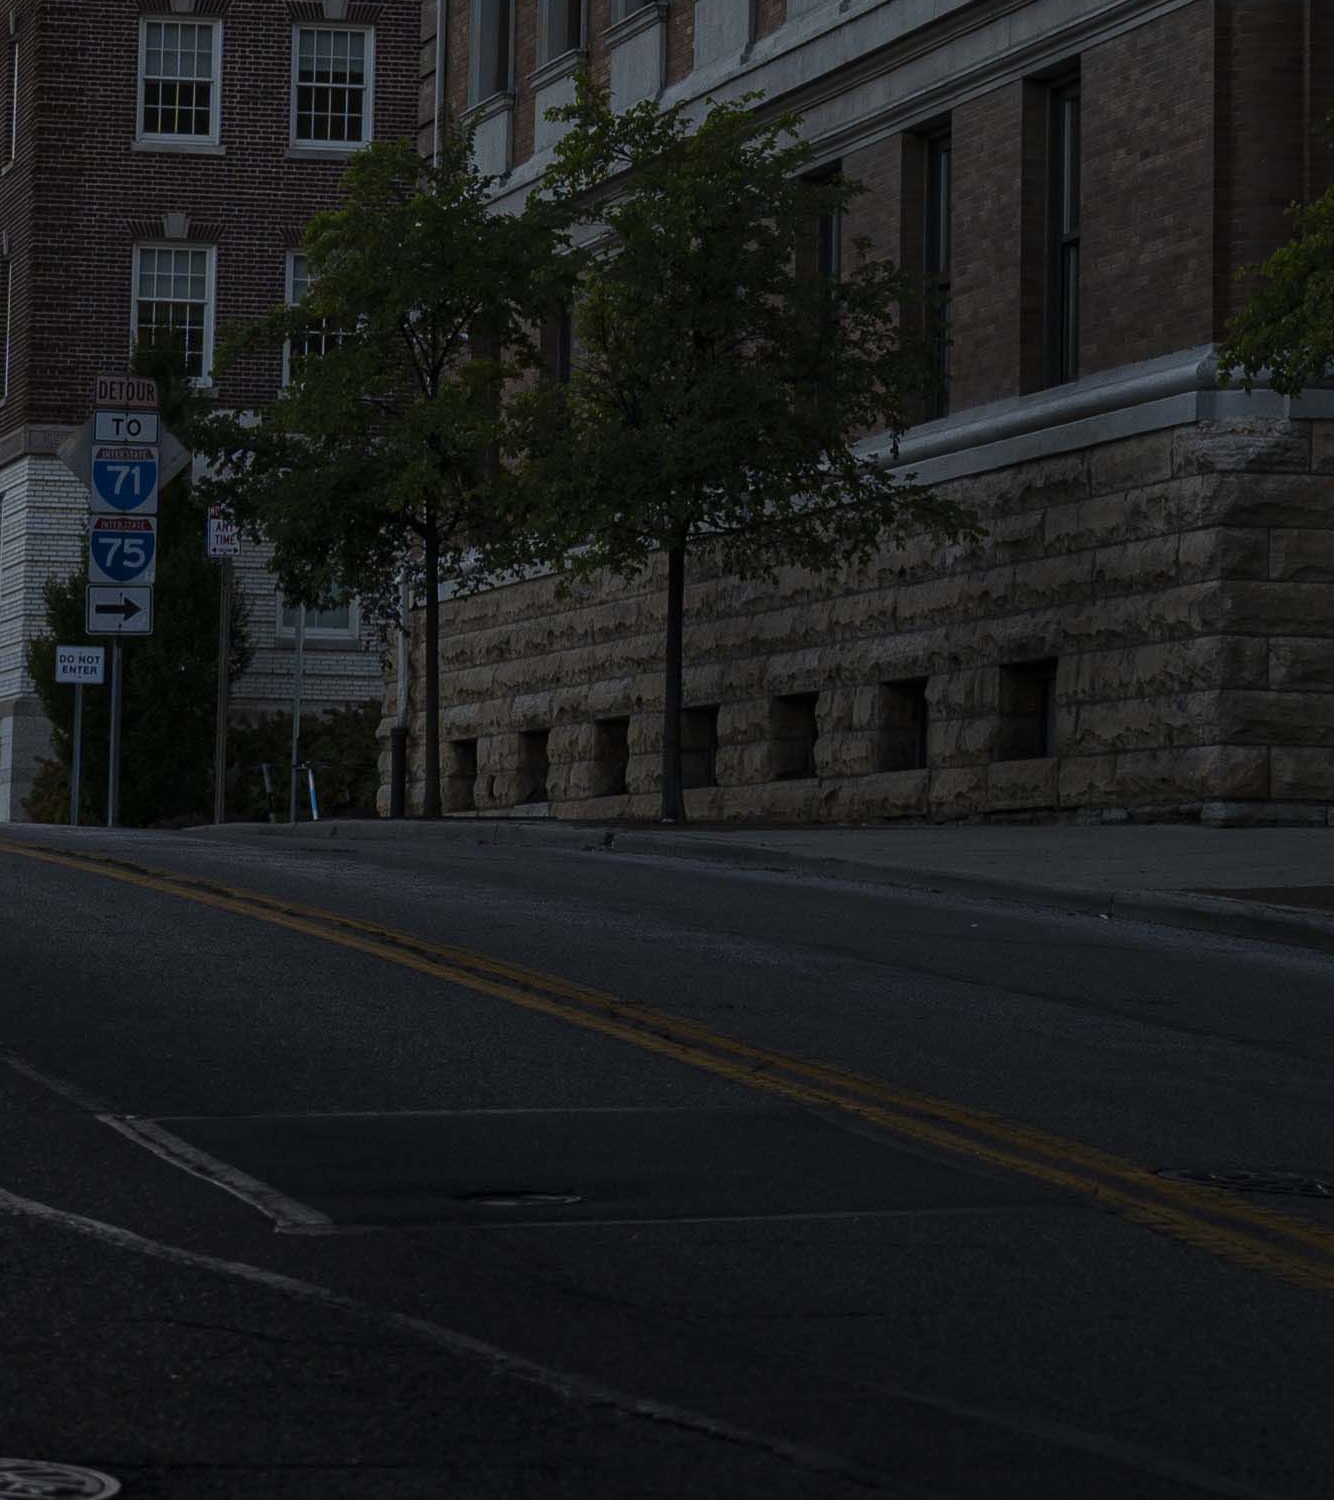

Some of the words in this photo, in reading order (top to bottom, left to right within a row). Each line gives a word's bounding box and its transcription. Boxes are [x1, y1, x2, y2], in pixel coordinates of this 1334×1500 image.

[99, 381, 155, 400] DETOUR
[112, 418, 141, 436] TO
[107, 465, 141, 496] 71
[215, 535, 236, 545] TIME
[98, 538, 146, 568] 75
[60, 655, 75, 664] DO
[79, 656, 100, 664] NOT
[63, 665, 97, 674] ENTER
